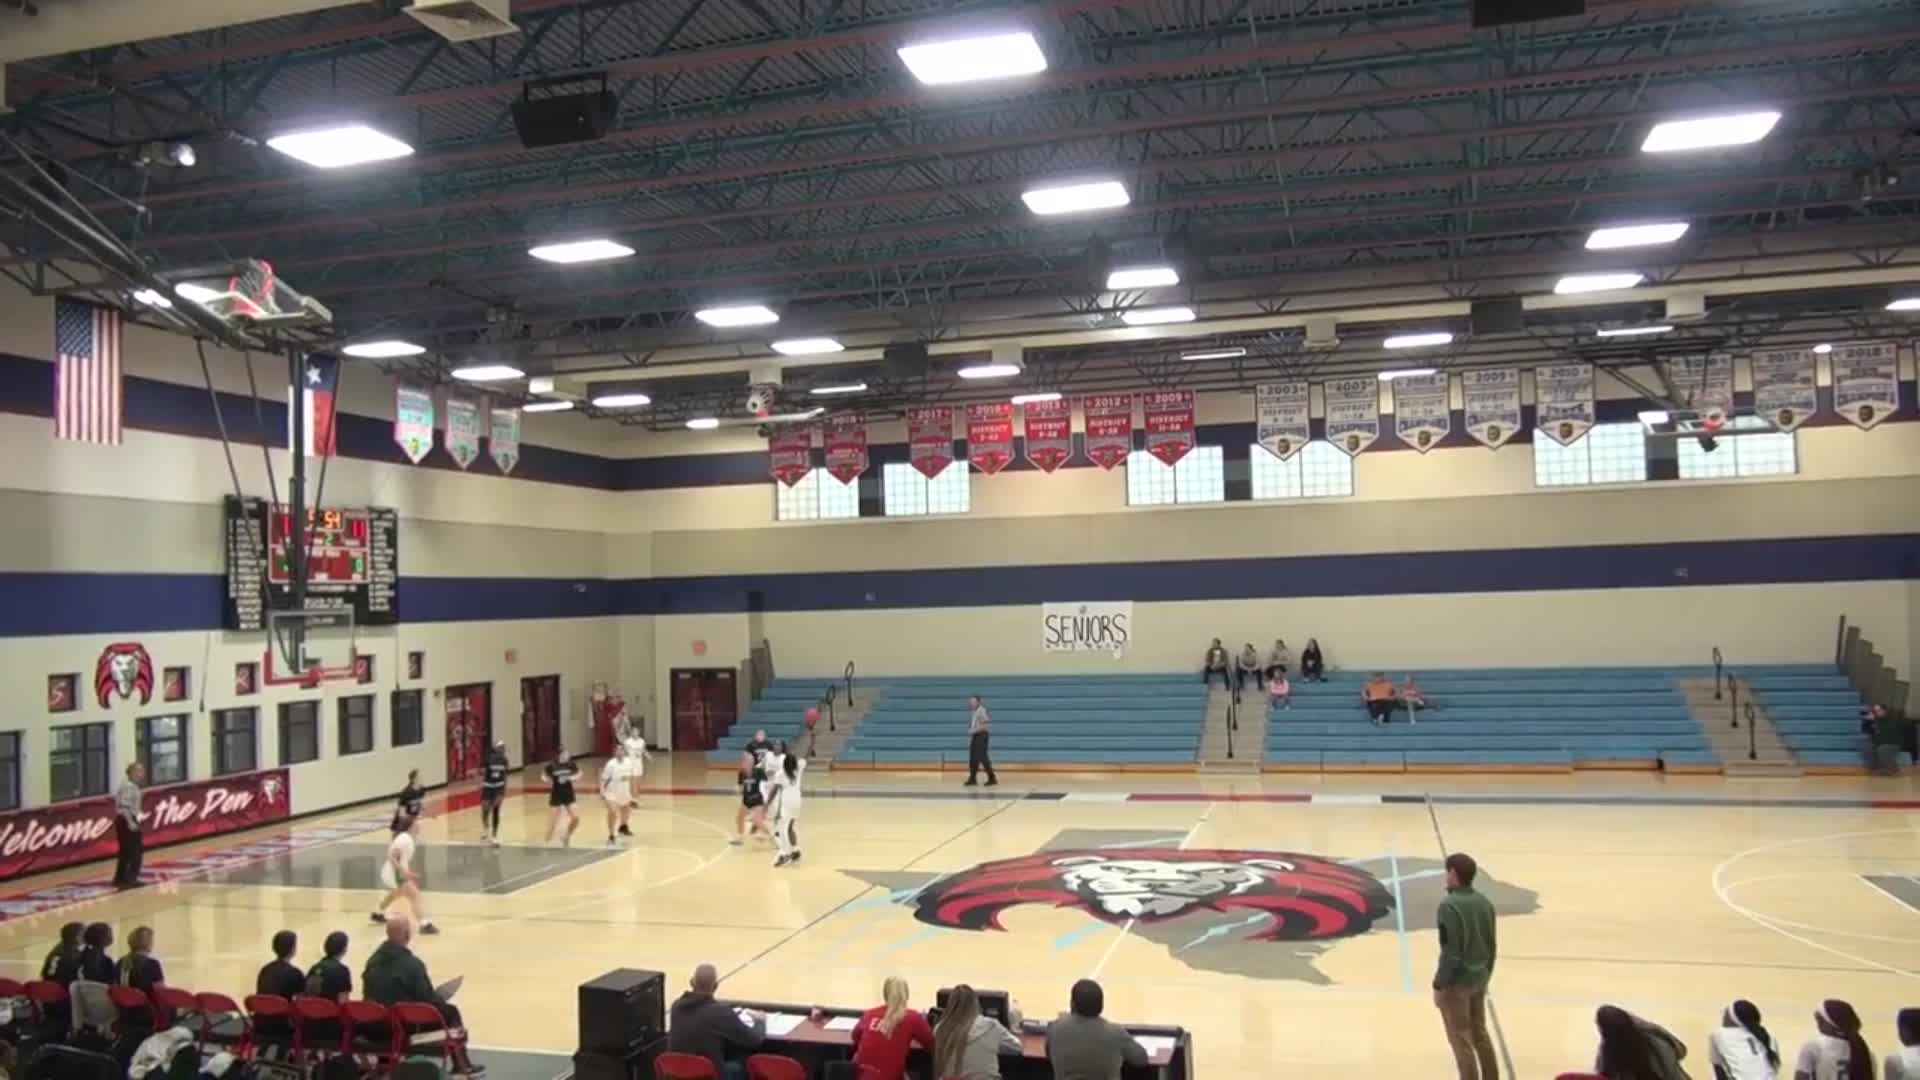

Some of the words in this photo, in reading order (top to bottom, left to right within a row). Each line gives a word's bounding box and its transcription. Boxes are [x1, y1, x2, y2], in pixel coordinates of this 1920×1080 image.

[1267, 385, 1298, 396] 2003
[1155, 392, 1183, 403] 2009
[1149, 415, 1190, 424] DISTRICT
[971, 424, 1009, 434] DISTRICT
[1029, 422, 1067, 431] DISTRICT
[1045, 614, 1127, 645] SENIORS
[152, 795, 198, 829] the
[199, 787, 255, 820] Den
